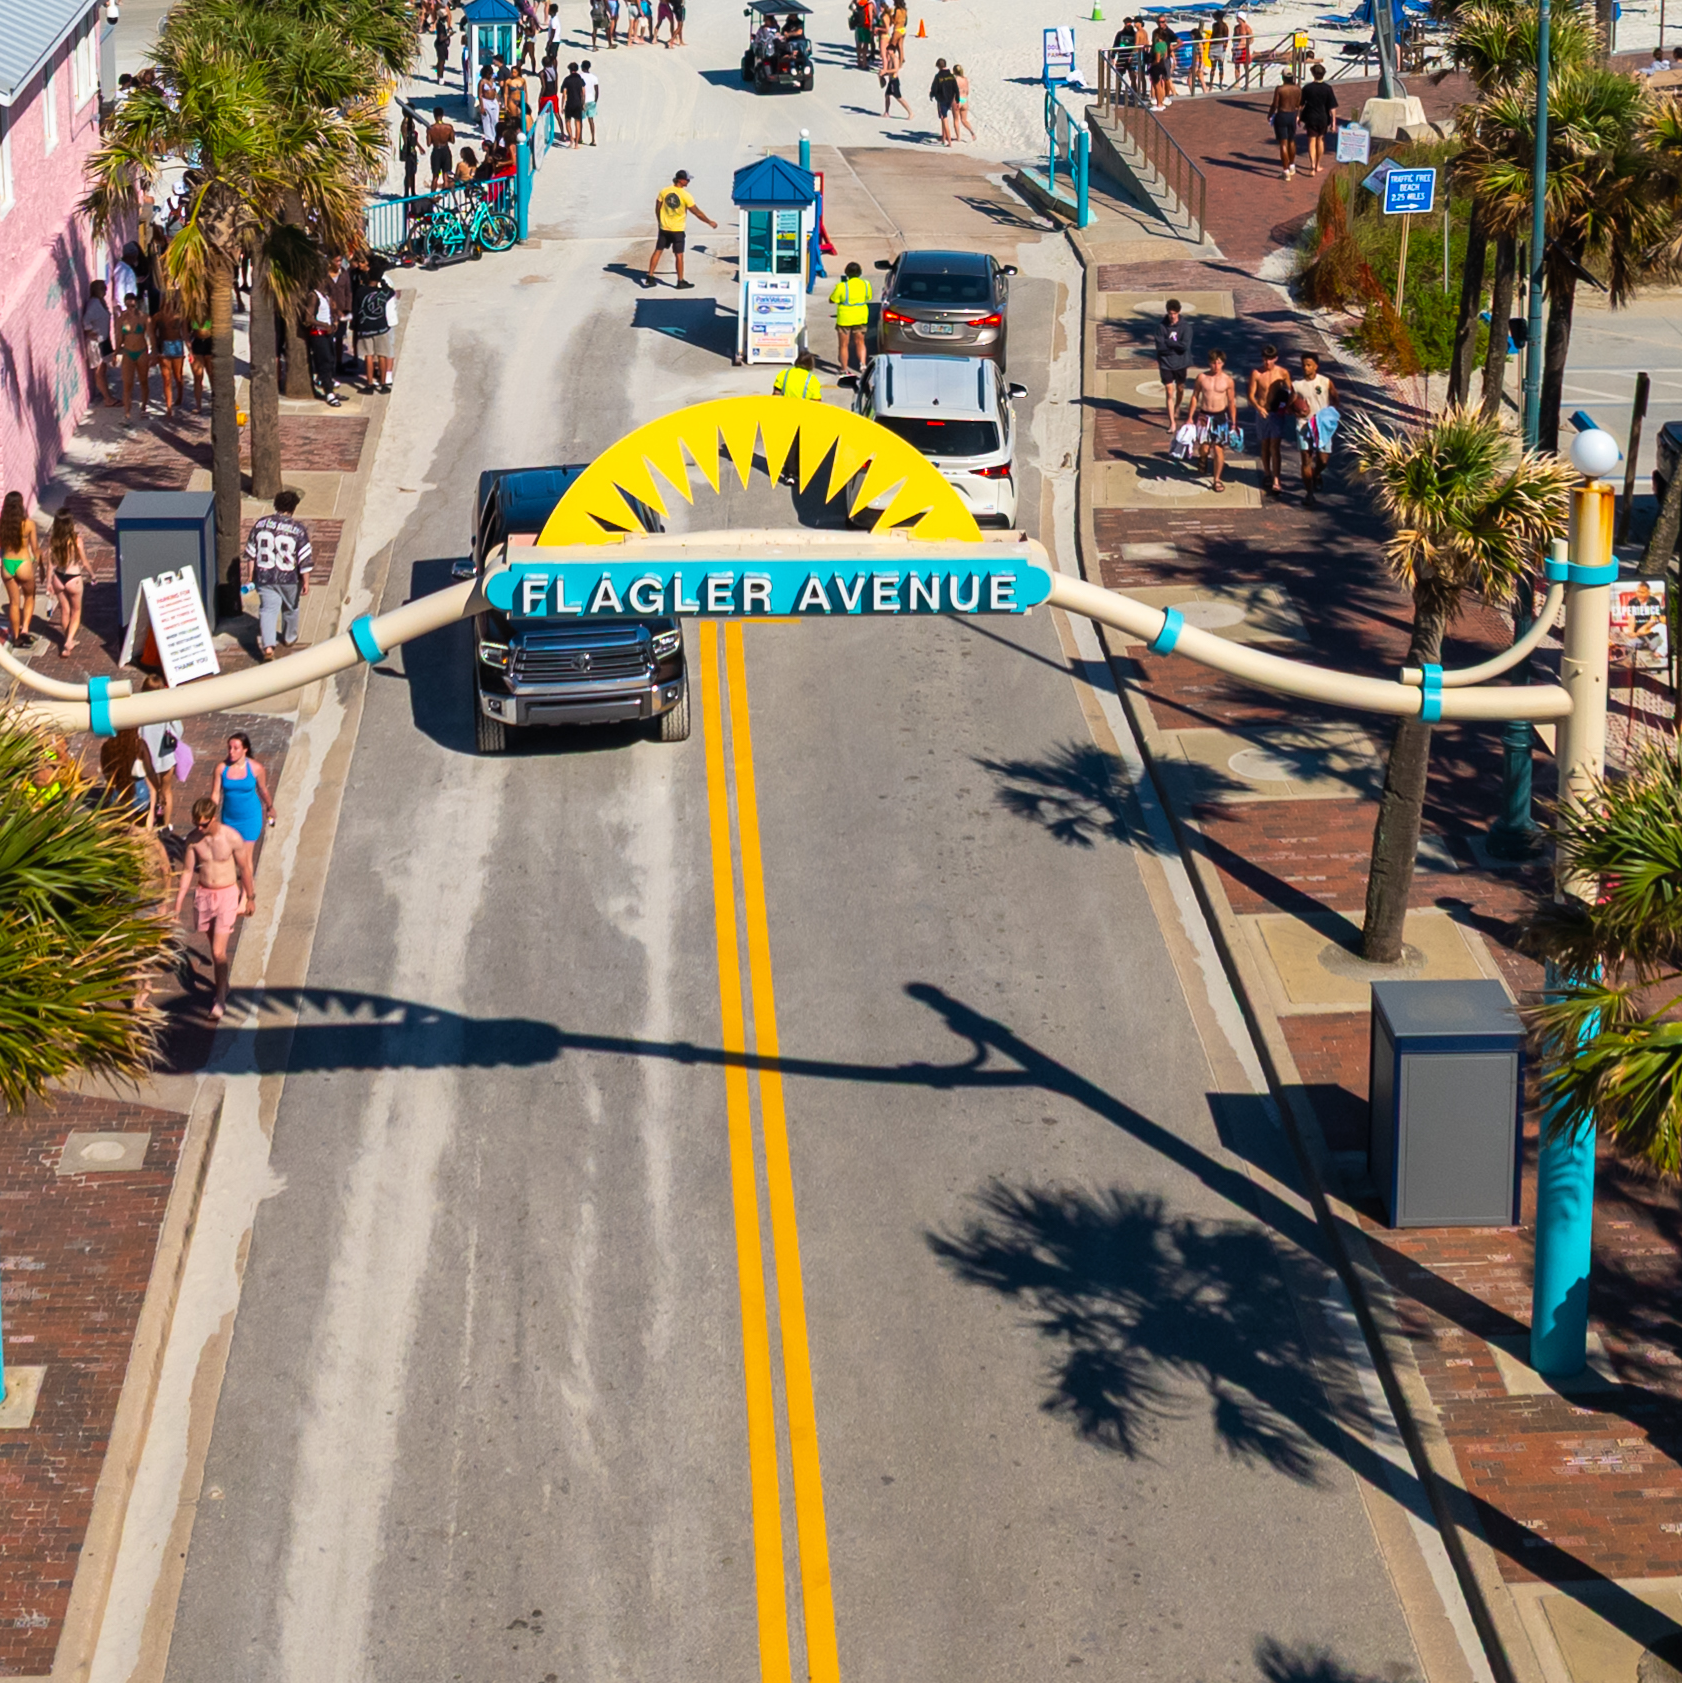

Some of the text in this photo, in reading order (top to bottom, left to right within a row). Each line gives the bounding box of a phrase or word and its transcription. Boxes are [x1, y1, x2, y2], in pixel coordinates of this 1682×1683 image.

[1390, 174, 1431, 182] TRAFFIC FREE
[256, 530, 296, 571] 88
[522, 572, 1018, 613] FLAGLER AVENUE
[1612, 605, 1660, 616] EXPERIENCE
